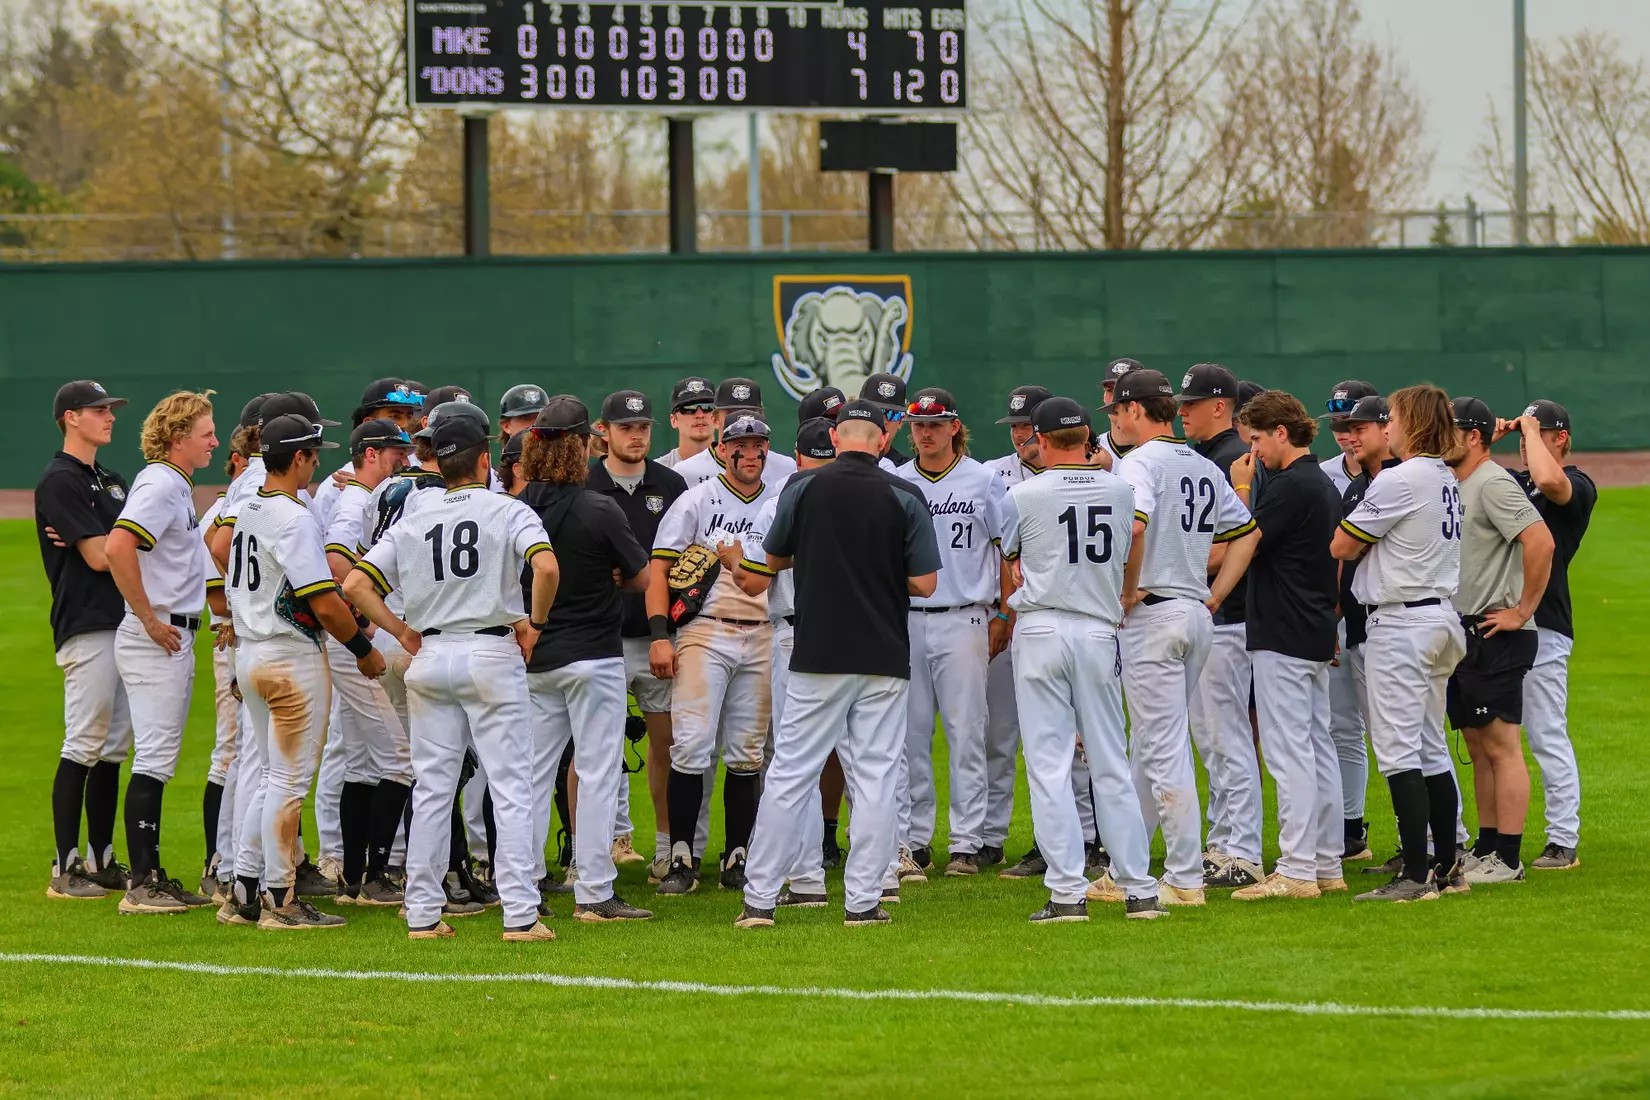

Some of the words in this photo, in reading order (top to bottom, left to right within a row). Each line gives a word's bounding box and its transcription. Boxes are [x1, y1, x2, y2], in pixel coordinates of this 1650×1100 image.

[522, 1, 534, 24] 1
[549, 3, 563, 25] 2
[578, 3, 591, 25] 3
[611, 4, 625, 25] 4
[640, 5, 653, 26] 5
[667, 5, 681, 26] 6
[702, 5, 715, 26] 7
[729, 6, 742, 27] 8
[756, 6, 769, 27] 9
[786, 7, 808, 28] 10
[821, 7, 869, 30] RUNS
[883, 7, 923, 30] HITS
[432, 25, 491, 55] MKE
[517, 24, 538, 59] 0
[557, 27, 566, 57] 1
[574, 25, 595, 60] 0
[608, 25, 629, 60] 0
[639, 26, 657, 61] 3
[664, 26, 685, 61] 0
[698, 26, 718, 61] 0
[726, 27, 746, 62] 0
[753, 28, 774, 62] 0
[847, 31, 867, 61] 4
[907, 30, 924, 62] 7
[939, 31, 958, 64] 0
[520, 64, 538, 99] 3
[546, 64, 567, 99] 0
[575, 65, 595, 100] 0
[620, 67, 629, 98] 1
[637, 66, 657, 100] 0
[667, 66, 685, 100] 3
[699, 66, 719, 101] 0
[727, 66, 747, 101] 0
[850, 68, 867, 100] 7
[893, 69, 925, 103] 12
[940, 69, 959, 103] 0
[1180, 476, 1216, 533] 32
[424, 520, 480, 582] 18
[951, 521, 973, 549] 21
[1058, 505, 1113, 564] 15
[231, 531, 261, 592] 16
